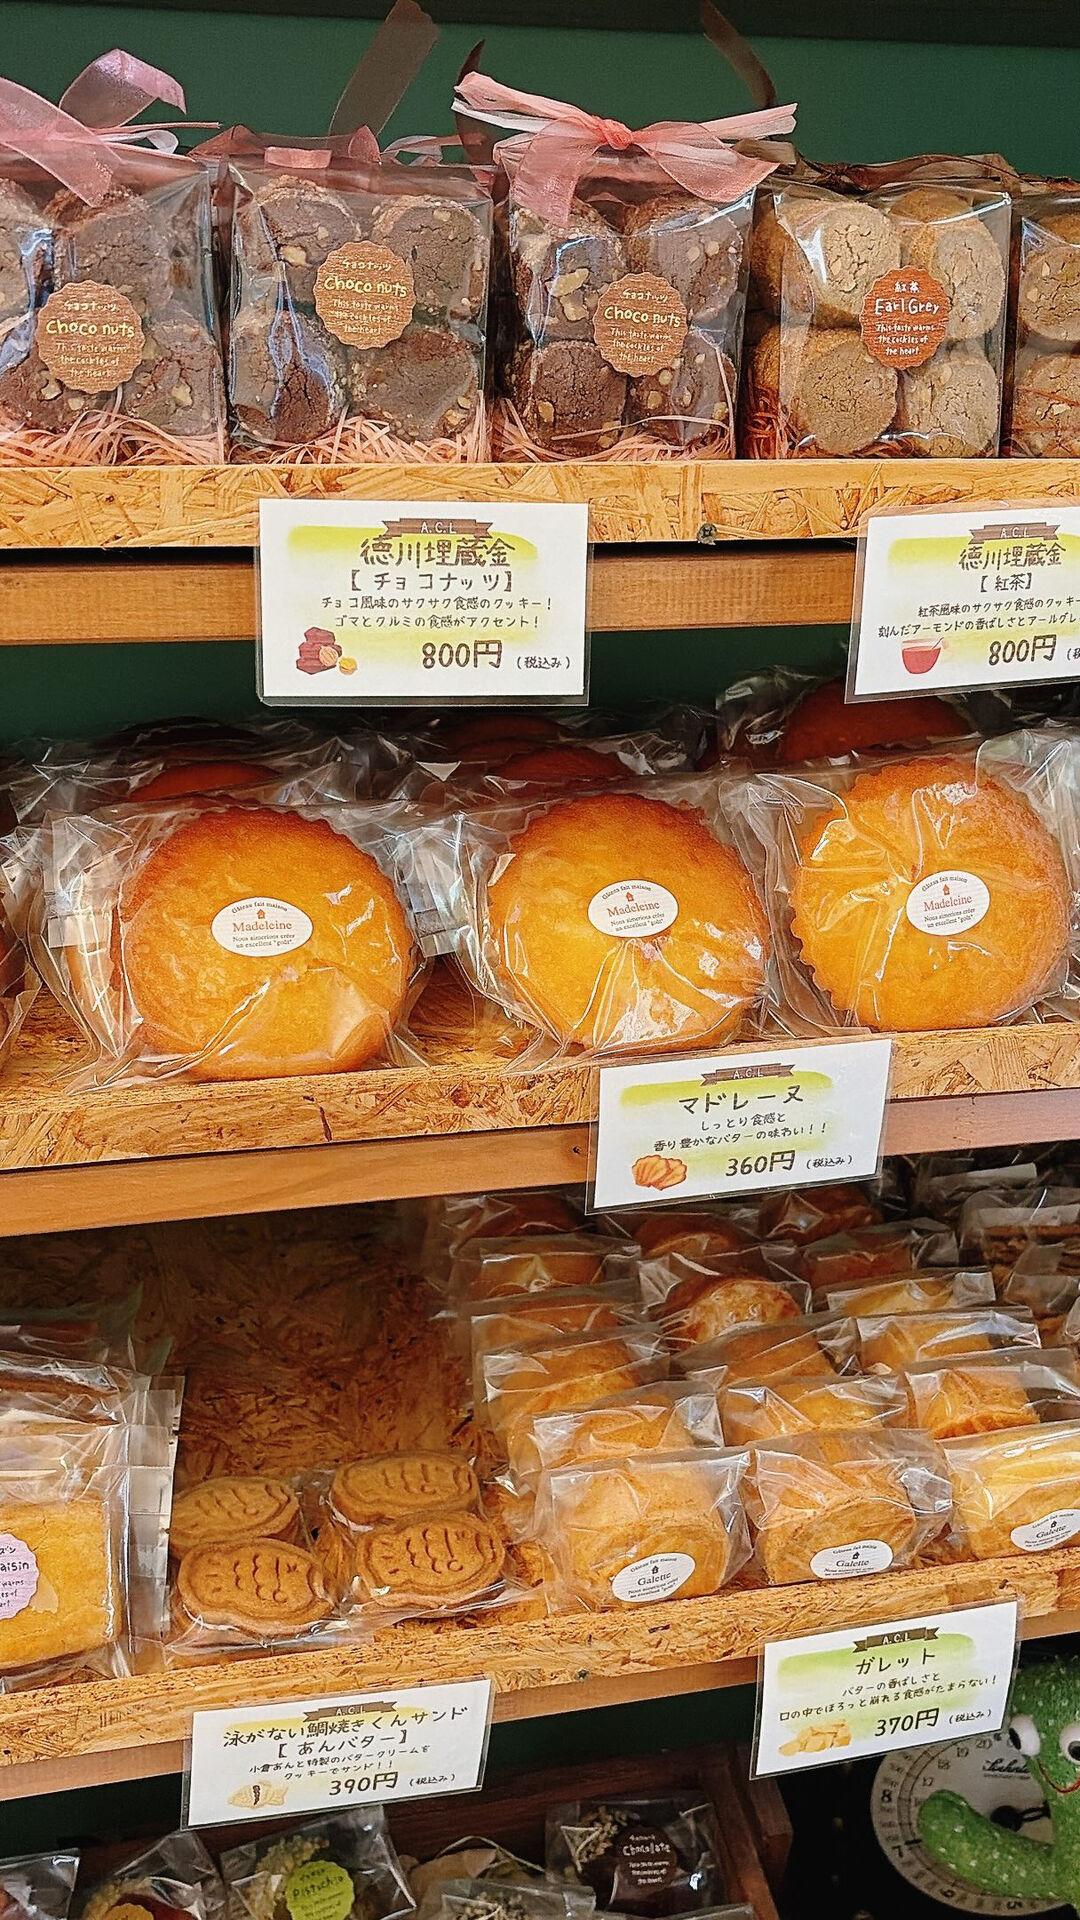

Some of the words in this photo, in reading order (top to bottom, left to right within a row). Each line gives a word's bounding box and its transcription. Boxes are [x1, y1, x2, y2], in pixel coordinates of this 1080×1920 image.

[324, 276, 372, 293] Choco
[377, 282, 407, 297] nuts
[895, 281, 920, 293] 紅茶
[604, 307, 648, 323] Choco
[653, 313, 680, 327] nuts
[875, 298, 904, 315] Earl
[908, 298, 939, 314] Grey
[46, 319, 97, 335] Choco
[102, 322, 134, 338] nuts
[360, 535, 515, 568] 徳川埋蔵金
[959, 542, 1066, 570] 徳川埋蔵金
[322, 596, 552, 610] チョコ風味のサクサク食感のクッキー！
[335, 615, 538, 628] ゴマとクルミの食感がアクセント！
[878, 613, 1080, 638] 刻んだアーモンドの香ばしさとアールグレ
[422, 640, 502, 669] 800円
[989, 634, 1057, 665] 800円
[608, 902, 659, 917] Madeleine
[924, 895, 972, 911] Madeleine
[232, 921, 292, 932] Madeleine
[679, 1085, 804, 1115] マドレーヌ
[701, 1113, 786, 1131] しっとり食感と
[654, 1122, 826, 1152] 香り豊かなバターの味わい！！
[725, 1150, 796, 1177] 360円
[638, 1572, 671, 1586] Galette
[856, 1648, 935, 1674] ガレット
[842, 1673, 940, 1696] バターの香ばしさと
[223, 1707, 469, 1748] 泳がない鯛焼きくんサンド
[875, 1708, 939, 1737] 370円
[329, 1772, 398, 1796] 390円
[623, 1842, 670, 1855] Chocolate
